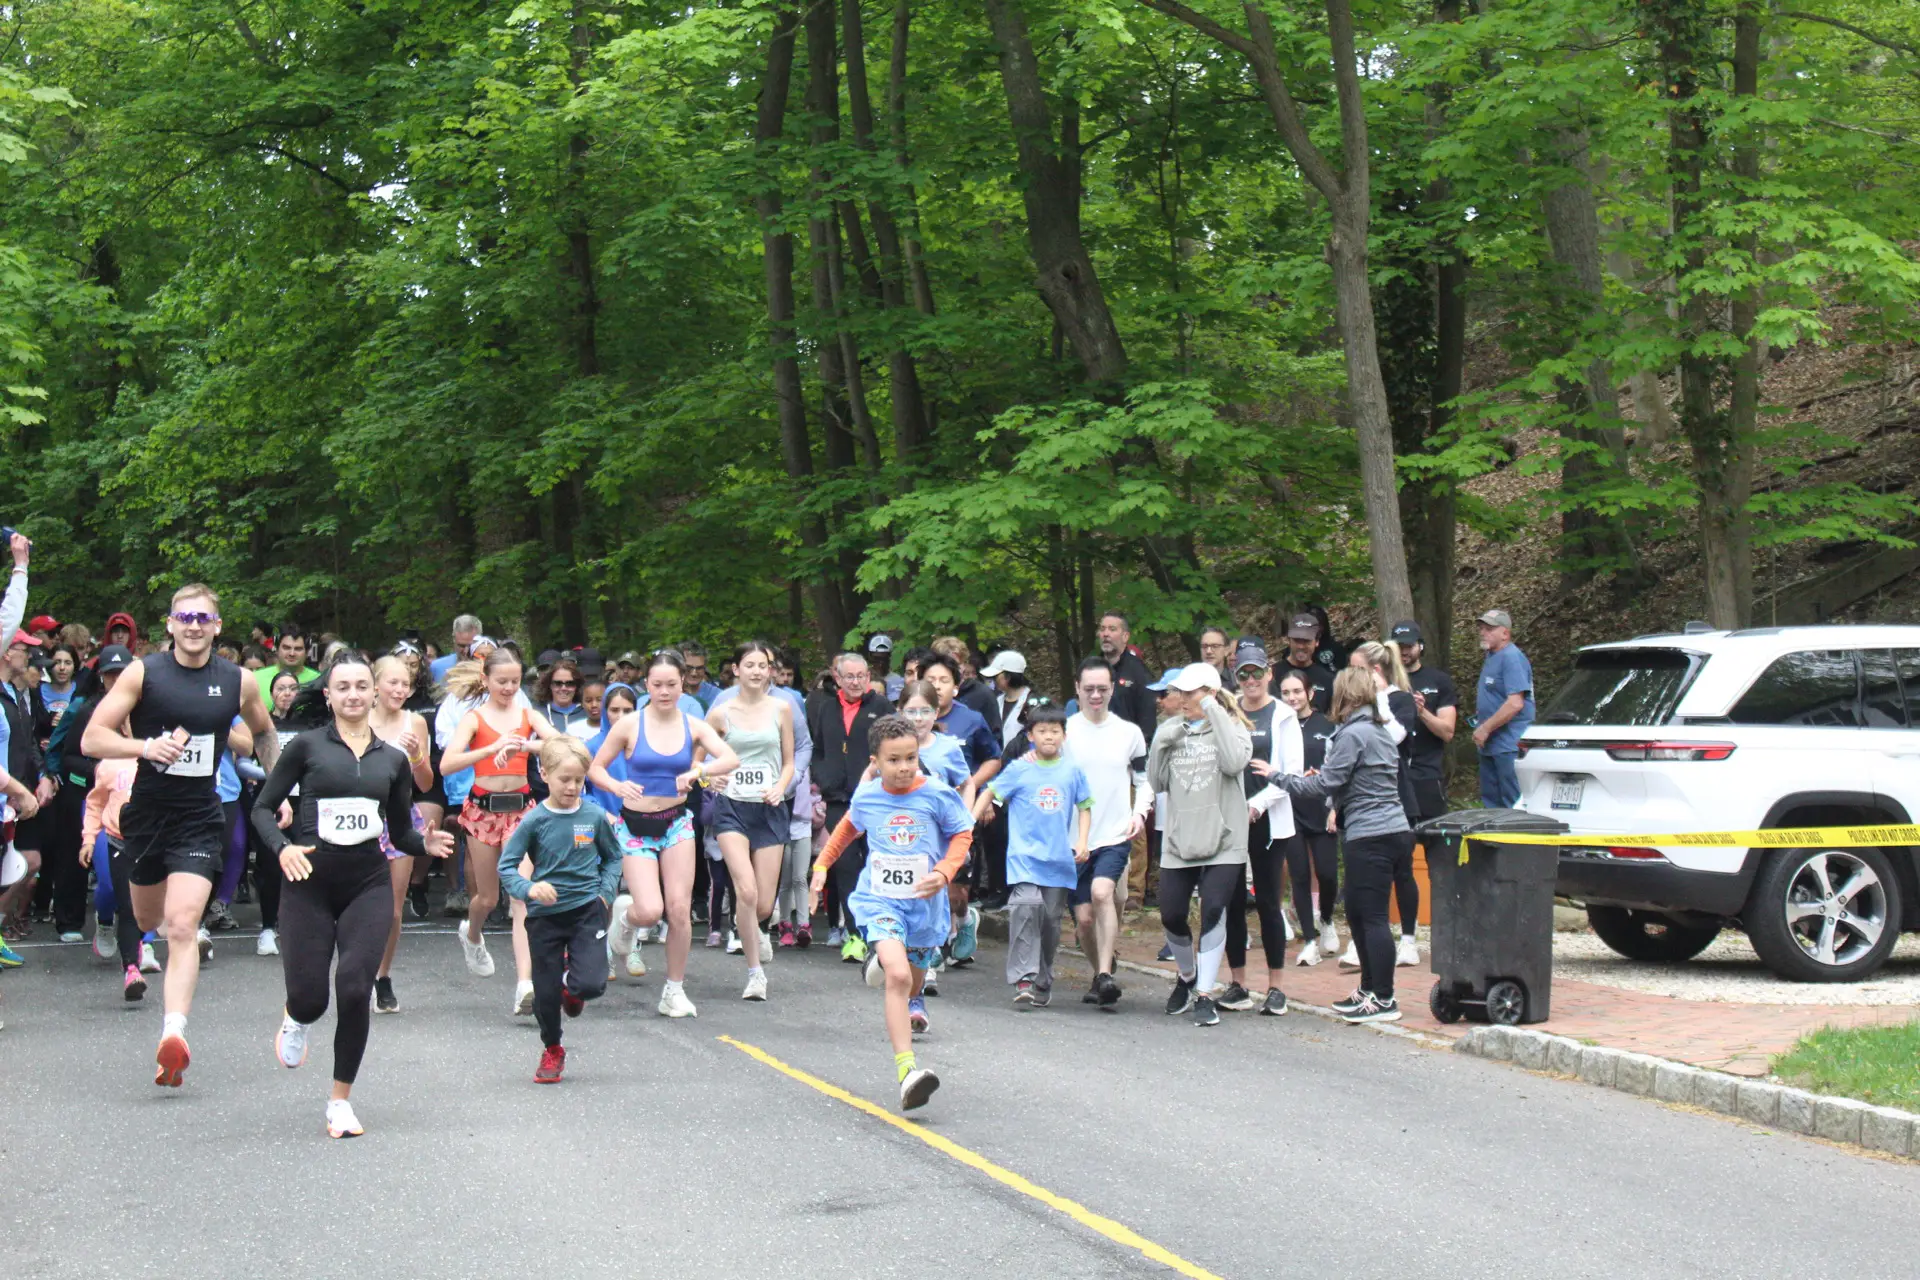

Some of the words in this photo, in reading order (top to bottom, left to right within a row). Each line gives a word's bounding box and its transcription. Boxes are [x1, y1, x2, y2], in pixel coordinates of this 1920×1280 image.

[735, 771, 764, 785] 989
[335, 814, 368, 830] 230
[1847, 830, 1869, 843] POLICE
[1878, 829, 1889, 842] DO
[1887, 829, 1900, 842] NOT
[882, 869, 914, 885] 263
